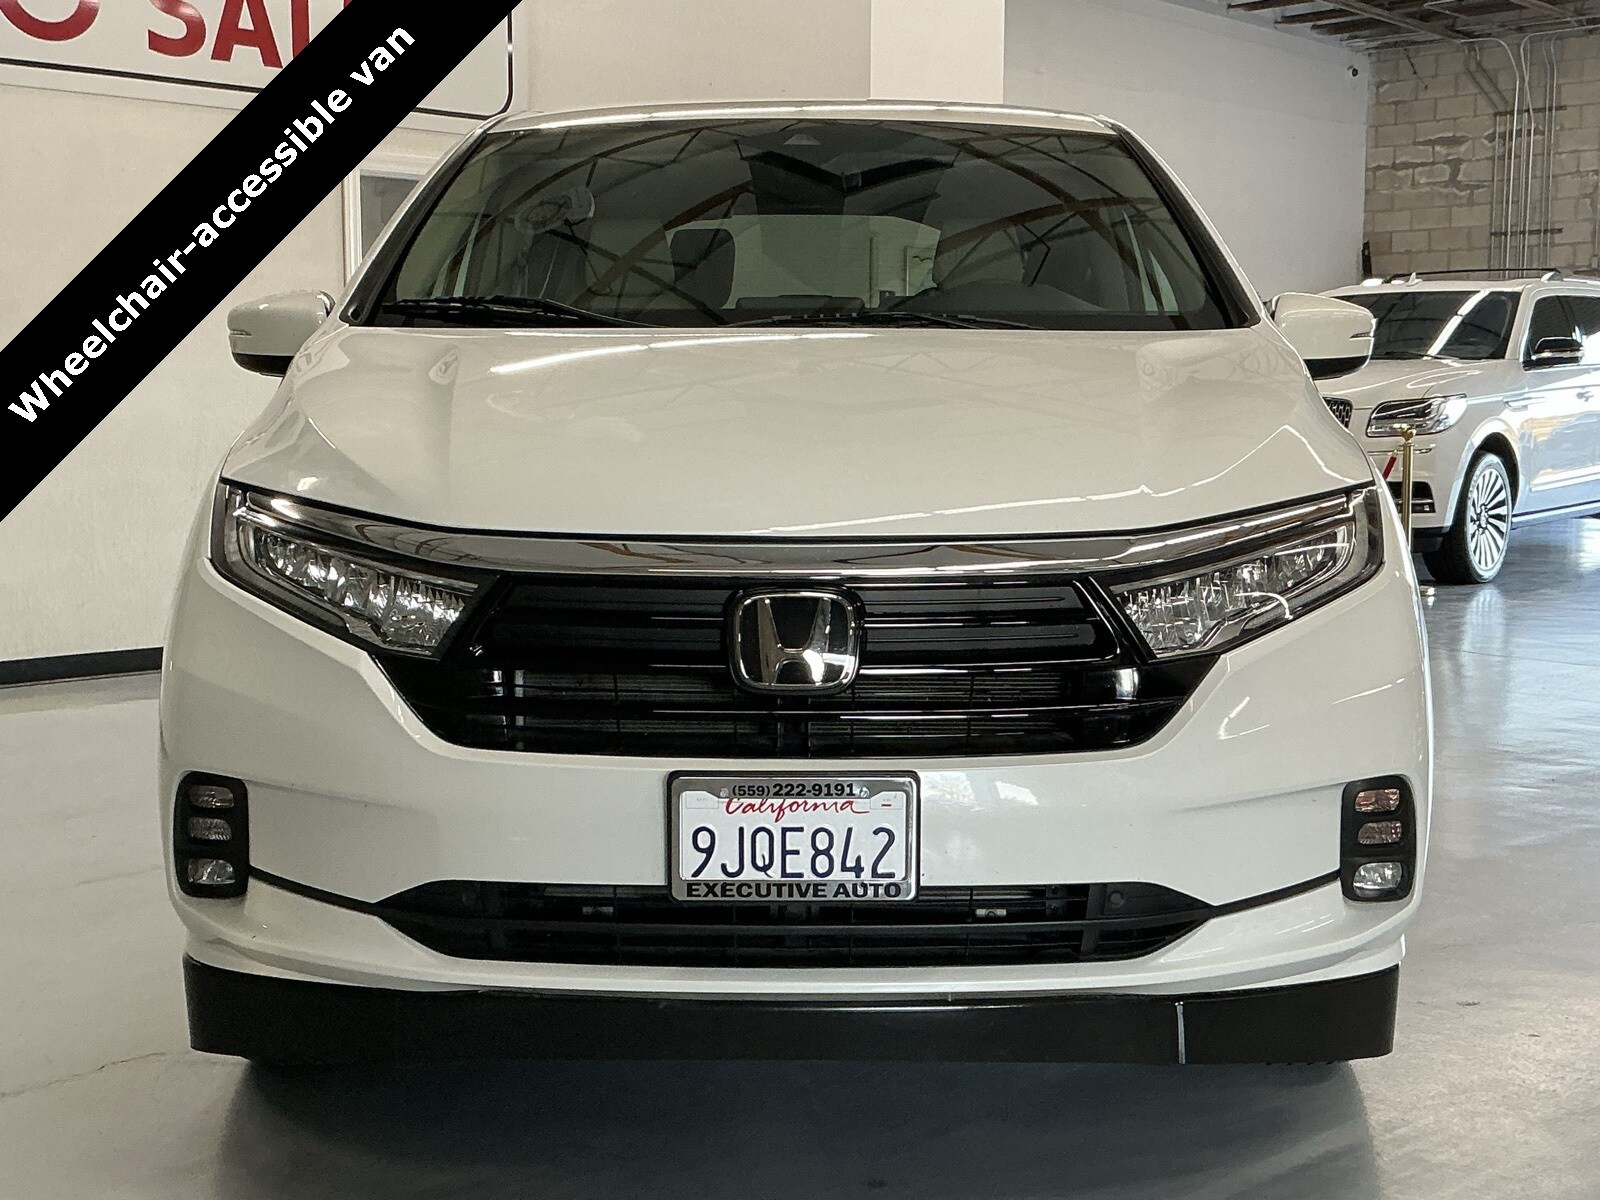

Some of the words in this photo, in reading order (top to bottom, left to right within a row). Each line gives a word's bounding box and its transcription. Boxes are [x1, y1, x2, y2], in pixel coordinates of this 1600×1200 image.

[732, 785, 770, 797] (559)
[773, 783, 856, 797] 222-9191
[725, 798, 870, 822] California
[691, 826, 896, 878] 9JQE842
[686, 883, 828, 898] EXECUTIVE
[833, 882, 902, 898] AUTO
